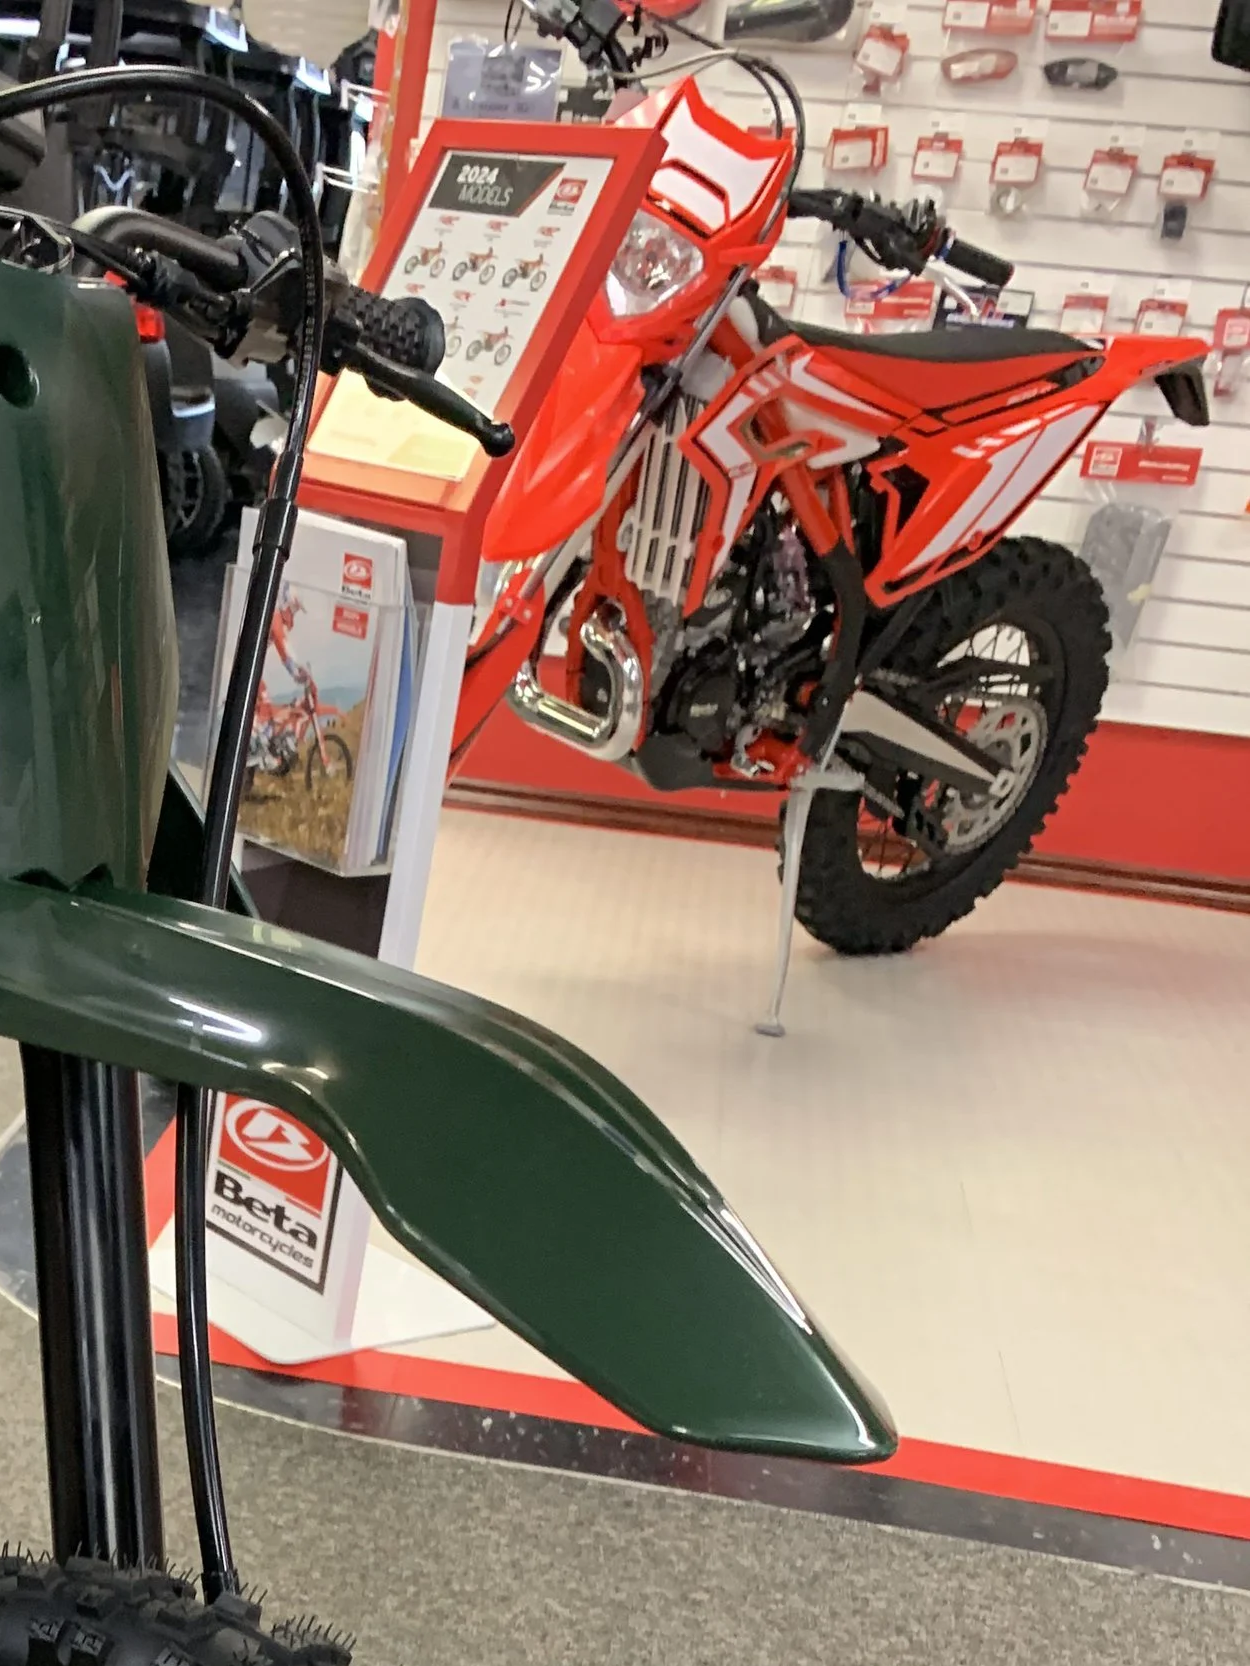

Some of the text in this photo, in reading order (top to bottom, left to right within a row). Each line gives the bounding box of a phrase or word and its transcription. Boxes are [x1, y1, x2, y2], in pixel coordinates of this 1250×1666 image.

[457, 164, 499, 184] 2024
[458, 185, 514, 207] MODELS
[214, 1169, 318, 1251] Beta
[211, 1204, 315, 1269] motorcycles
